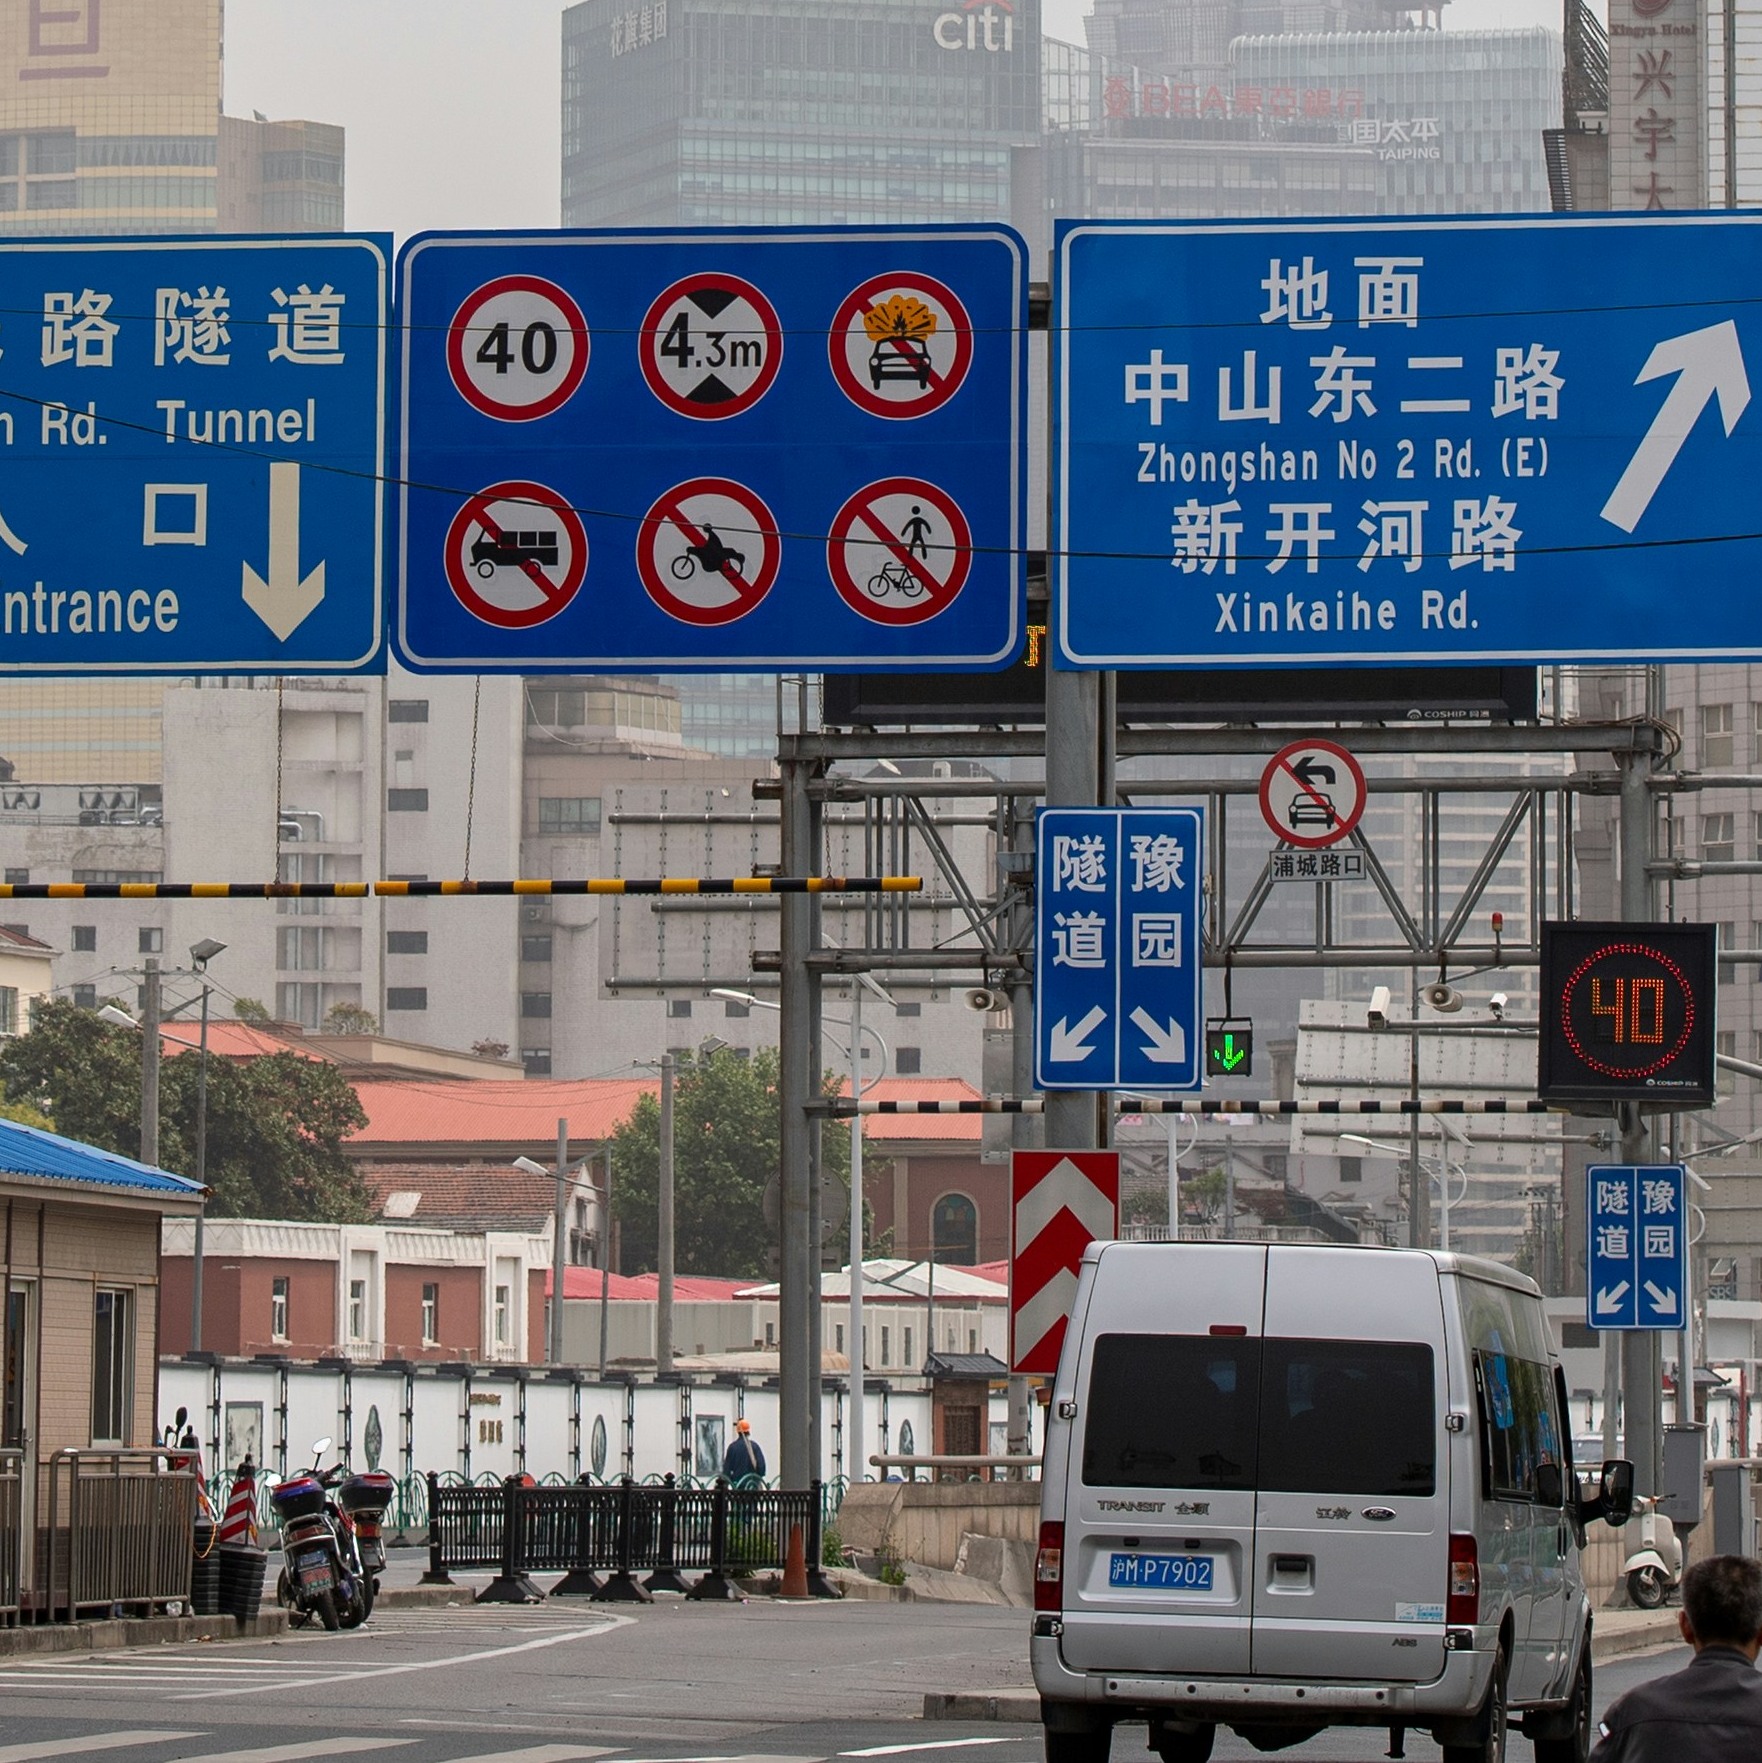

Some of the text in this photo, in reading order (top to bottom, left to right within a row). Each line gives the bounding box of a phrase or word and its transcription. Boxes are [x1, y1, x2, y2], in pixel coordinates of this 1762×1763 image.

[609, 0, 667, 59] 花旗集团
[933, 3, 1013, 52] citi
[1611, 24, 1698, 37] Xingyu Hotel
[1144, 84, 1229, 114] BEA
[1377, 147, 1440, 161] TAIPING
[1633, 49, 1676, 210] 兴宇大
[1260, 255, 1424, 330] 地面
[476, 321, 557, 374] 40
[660, 312, 762, 368] 4.3m
[1124, 342, 1566, 426] 中山东二路
[41, 401, 108, 447] Rd.
[156, 398, 317, 444] Tunnel
[1137, 436, 1550, 493] Zhongshan No 2 Rd. (E)
[1171, 495, 1523, 575] 新开河路
[1215, 590, 1479, 633] Xinkaihe Rd.
[1423, 710, 1467, 718] COSHIP
[1274, 854, 1361, 877] 浦城路口
[1052, 835, 1107, 969] 隧道
[1130, 834, 1185, 969] 豫园
[1592, 978, 1664, 1043] 40
[1597, 1180, 1630, 1260] 隧道
[1642, 1180, 1675, 1259] 豫园
[1097, 1500, 1165, 1513] TRANSIT
[1392, 1638, 1418, 1647] ABS
